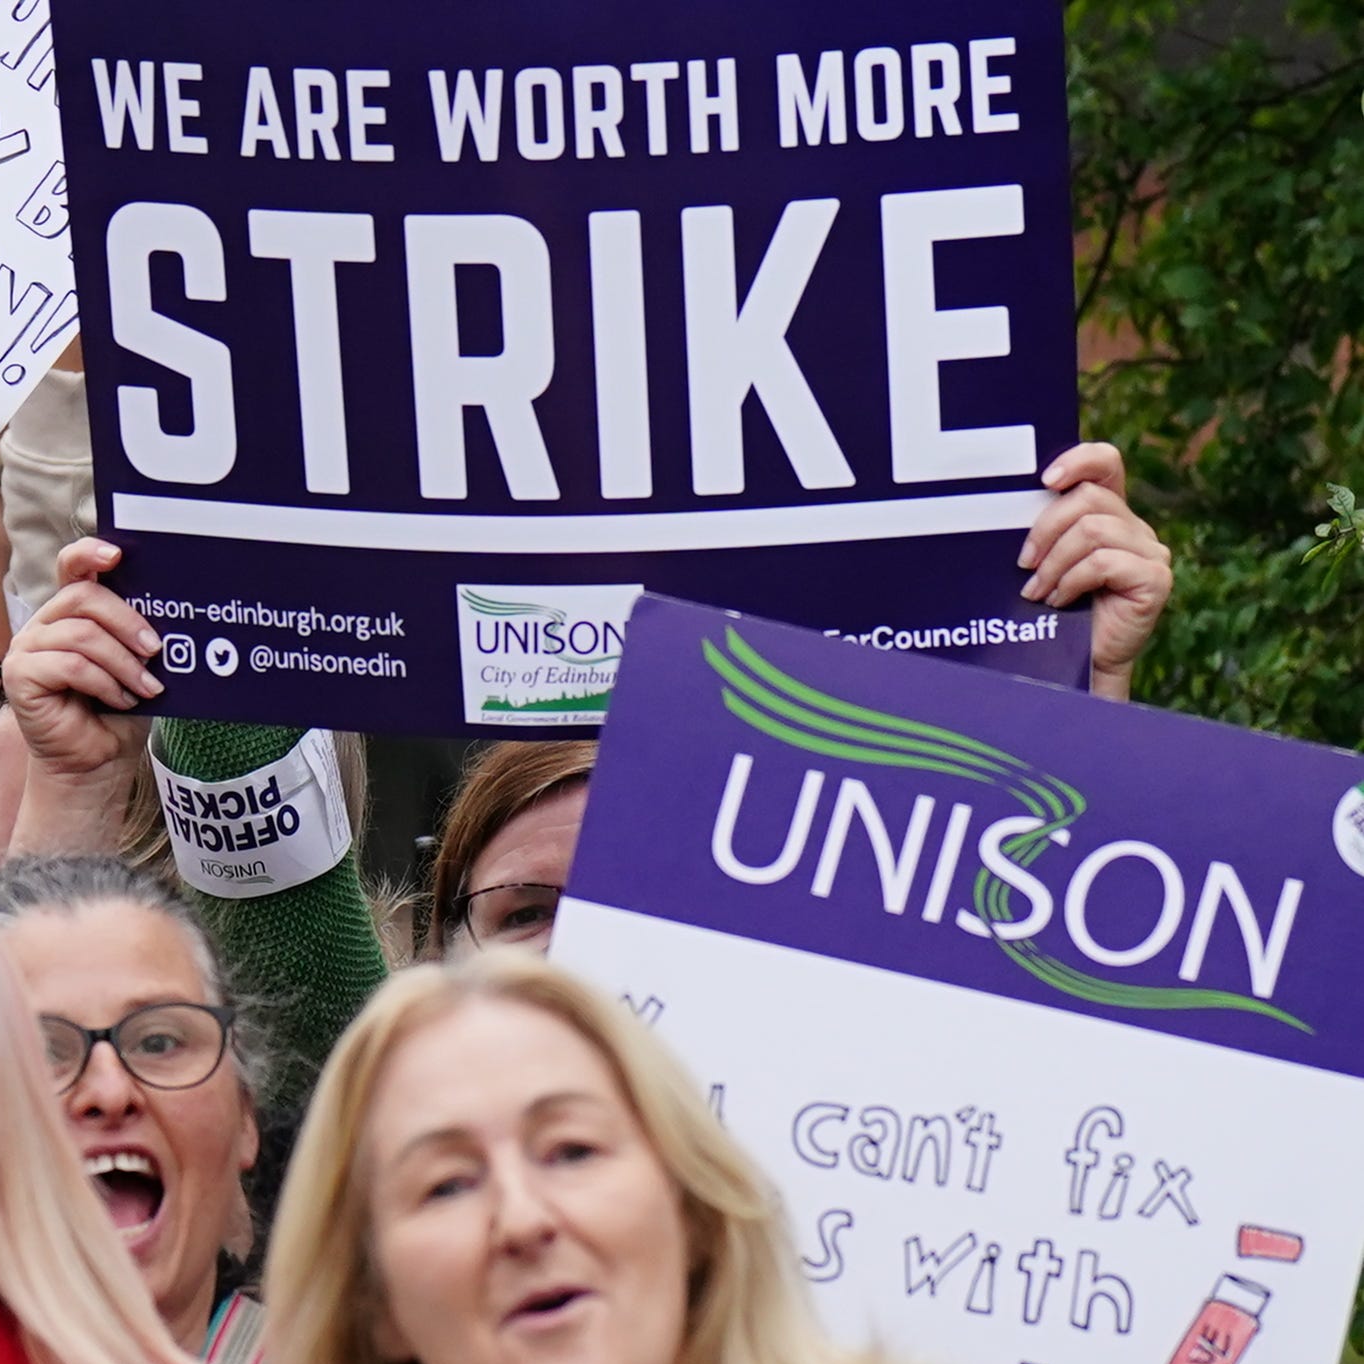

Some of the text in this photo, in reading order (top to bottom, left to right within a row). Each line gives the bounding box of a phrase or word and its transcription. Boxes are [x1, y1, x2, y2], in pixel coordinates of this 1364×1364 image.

[91, 36, 1021, 163] WE ARE WORTH MORE
[16, 160, 73, 260] B
[105, 183, 1039, 502] STRIKE
[249, 644, 407, 679] @unisonedin
[475, 620, 628, 655] UNISON
[480, 665, 517, 688] City
[522, 666, 543, 688] of
[166, 775, 283, 821] PICKET
[166, 803, 300, 853] OFFICIAL
[200, 859, 267, 881] UNISON
[710, 751, 1305, 1000] UNISON
[791, 1098, 1003, 1193] can't
[1064, 1105, 1200, 1227] fix
[904, 1232, 1136, 1335] with
